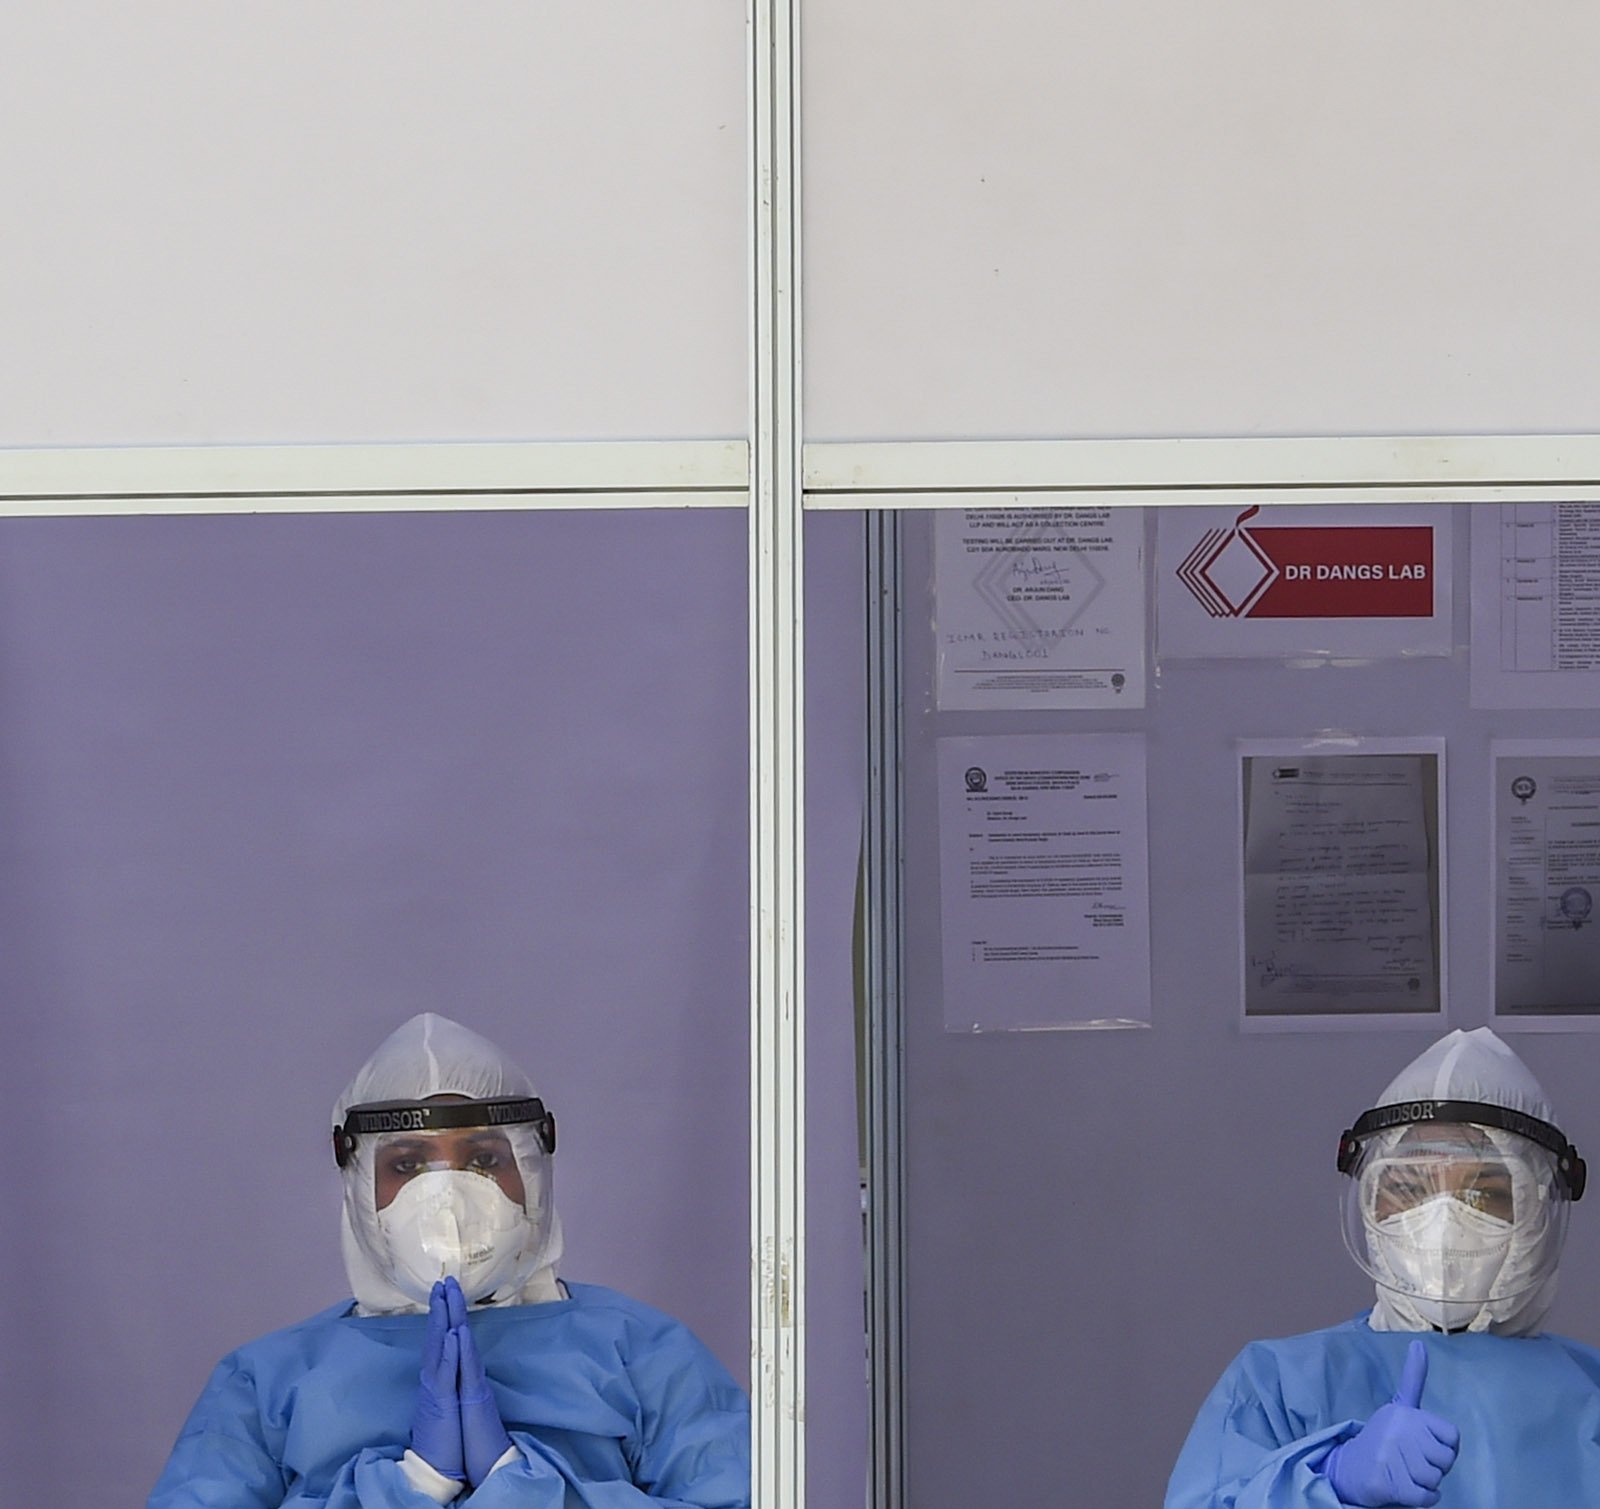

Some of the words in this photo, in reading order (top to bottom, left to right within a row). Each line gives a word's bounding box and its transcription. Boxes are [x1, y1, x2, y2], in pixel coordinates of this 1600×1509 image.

[1286, 565, 1311, 580] DR
[1317, 565, 1383, 580] DANGS
[1389, 565, 1425, 579] LAB
